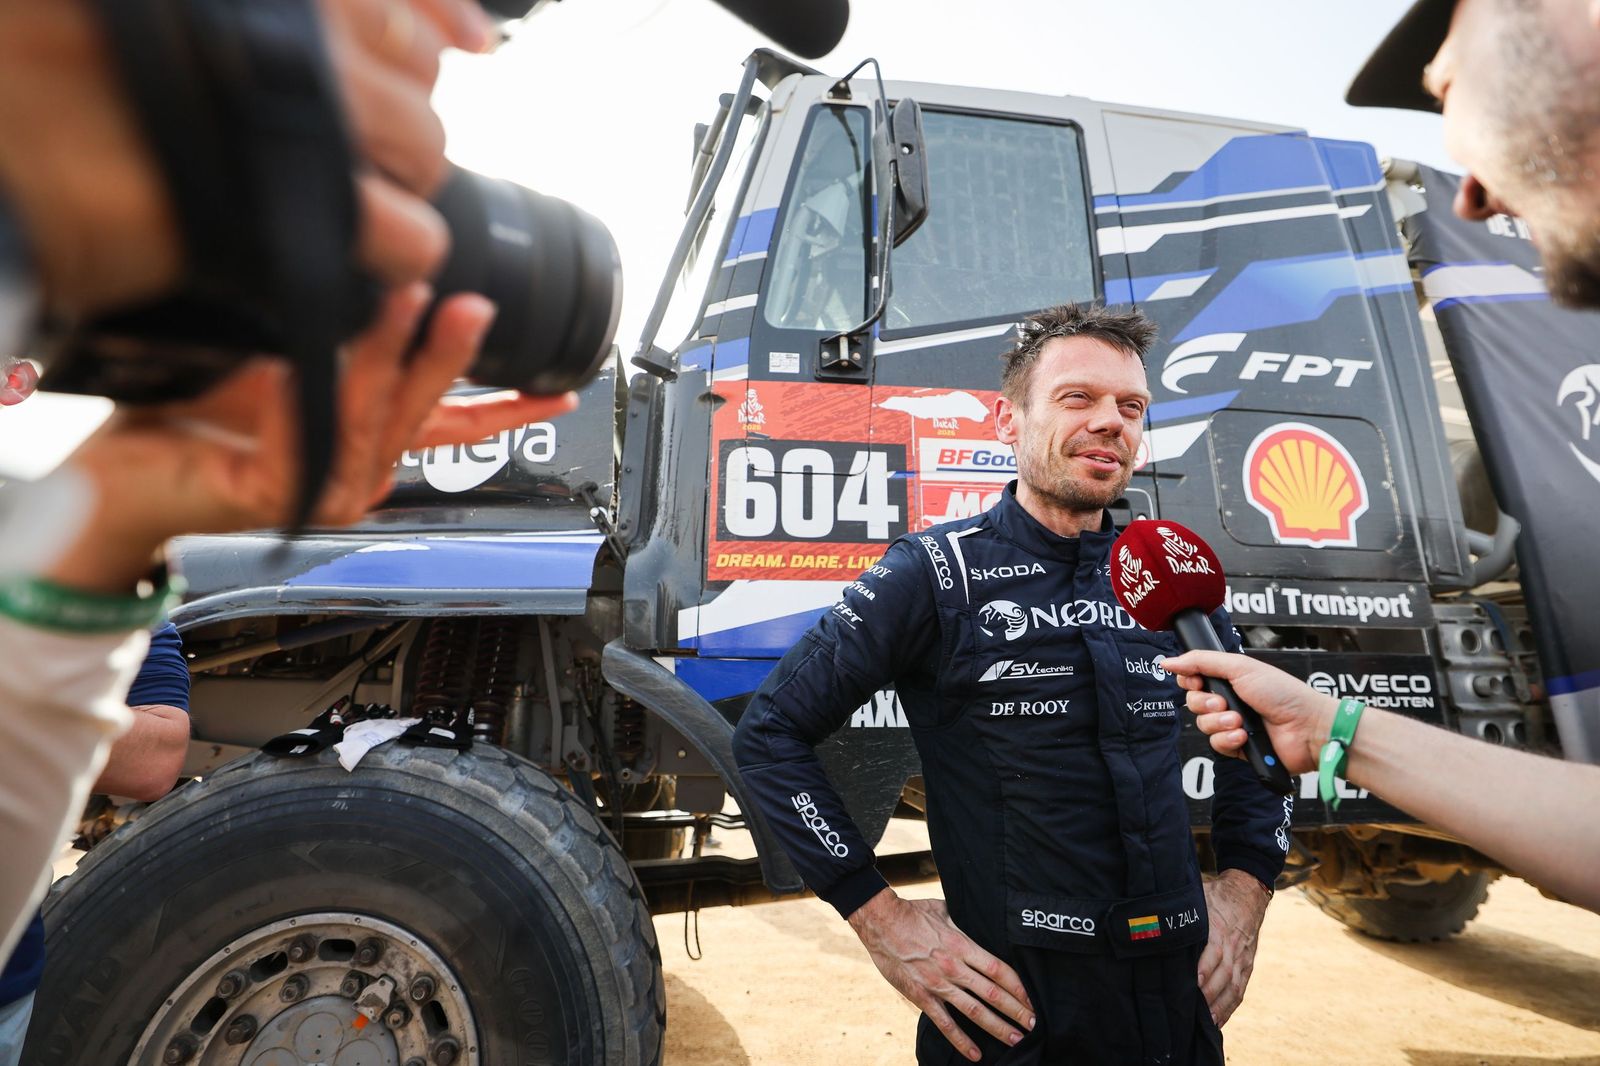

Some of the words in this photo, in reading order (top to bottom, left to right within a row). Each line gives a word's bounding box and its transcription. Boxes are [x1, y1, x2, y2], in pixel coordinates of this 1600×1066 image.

[1238, 351, 1374, 388] FPT
[725, 446, 899, 540] 604
[716, 554, 787, 568] DREAM.
[790, 554, 843, 569] DARE.
[919, 535, 954, 591] sparco
[1165, 555, 1216, 575] DAKAR
[1123, 569, 1160, 609] DAKAR
[834, 602, 864, 623] FPT
[1281, 587, 1414, 623] Transport
[1340, 674, 1431, 693] IVECO
[990, 702, 1015, 716] DE
[1019, 699, 1070, 716] ROOY
[791, 792, 849, 858] sparco
[1021, 908, 1095, 936] sparco
[1165, 916, 1177, 930] V.
[1178, 908, 1200, 926] ZALA
